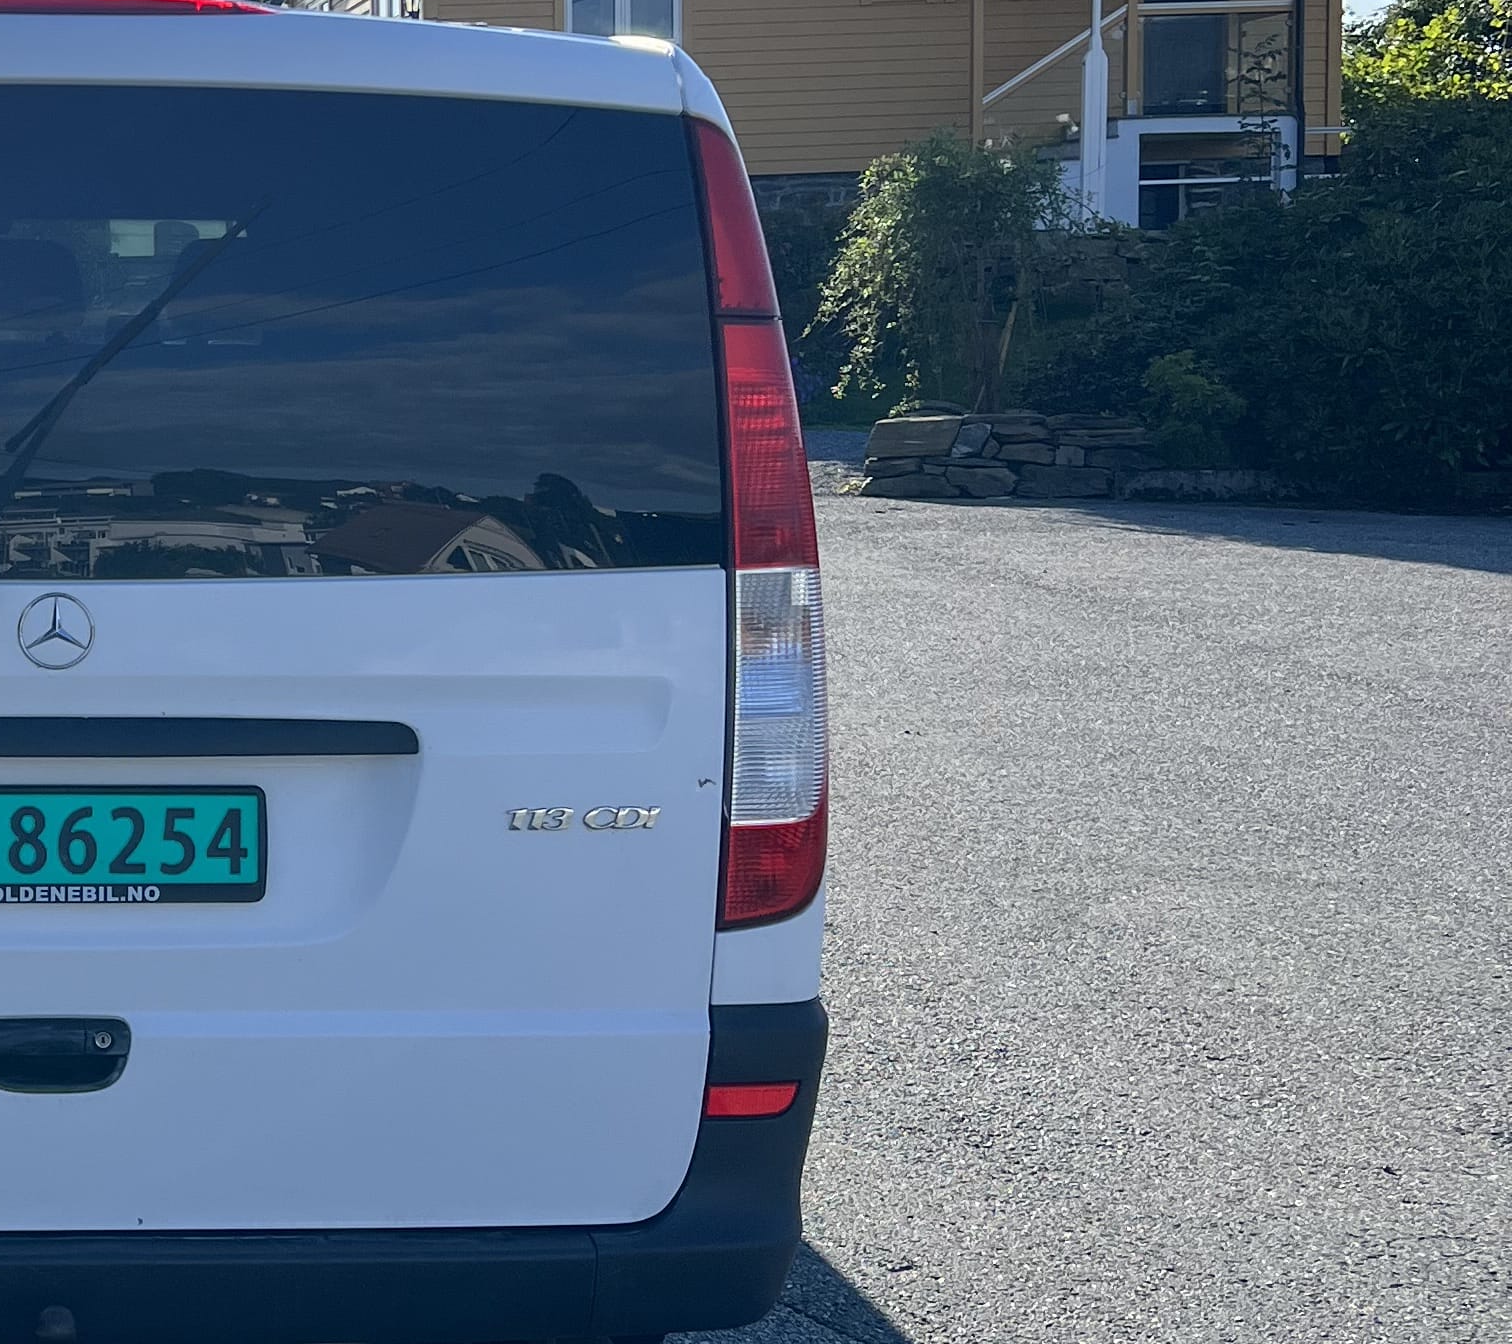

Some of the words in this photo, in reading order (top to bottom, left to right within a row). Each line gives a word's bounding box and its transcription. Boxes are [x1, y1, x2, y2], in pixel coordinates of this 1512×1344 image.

[7, 805, 249, 875] 86254
[506, 807, 574, 831] 113
[583, 806, 661, 830] CDI
